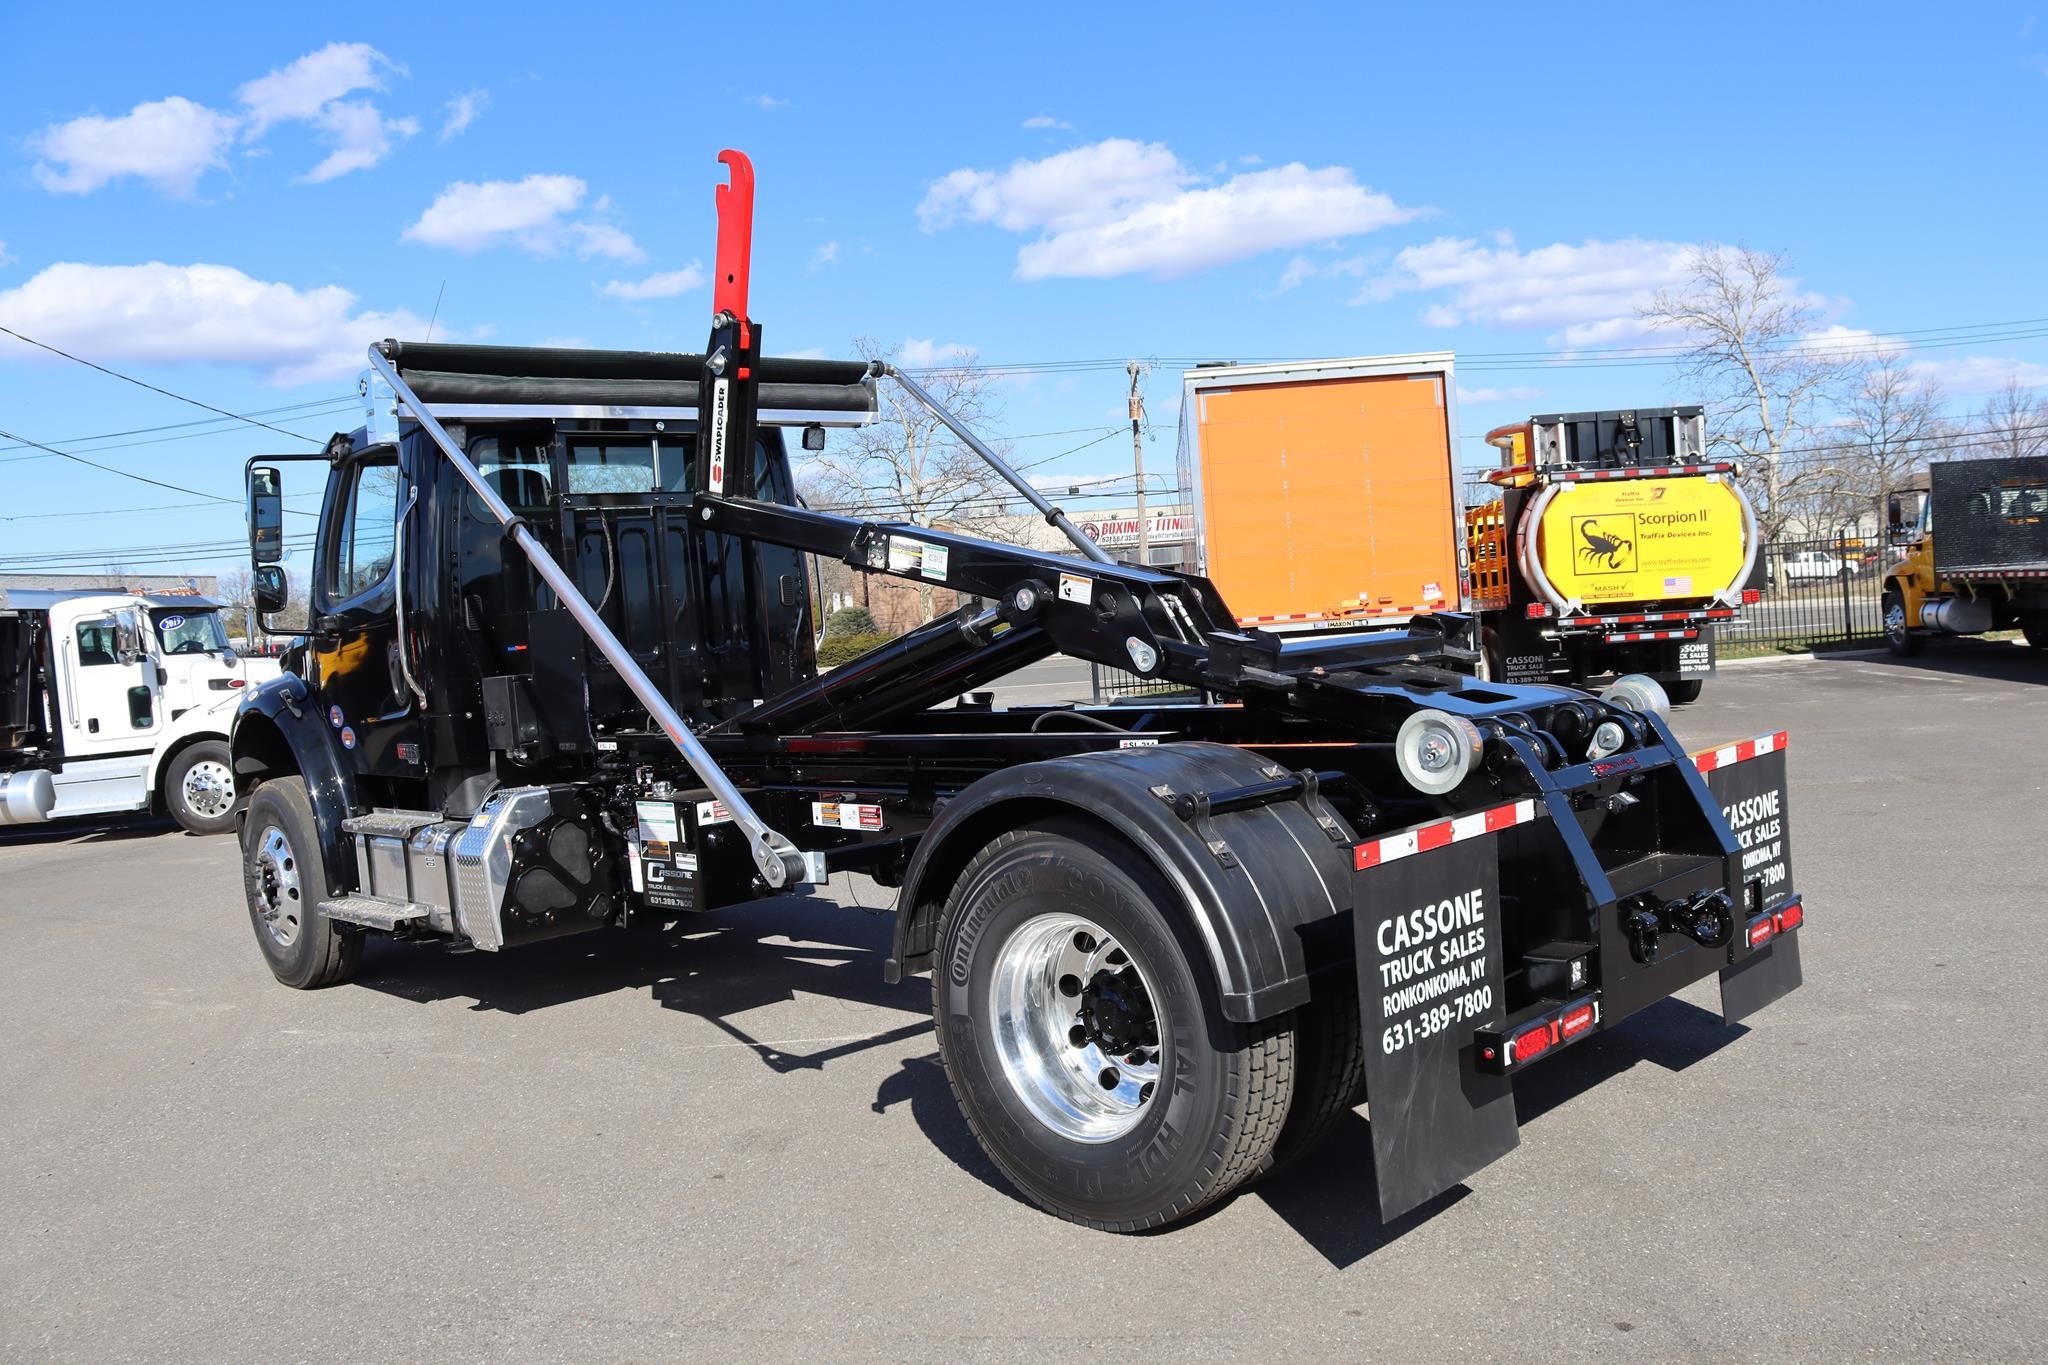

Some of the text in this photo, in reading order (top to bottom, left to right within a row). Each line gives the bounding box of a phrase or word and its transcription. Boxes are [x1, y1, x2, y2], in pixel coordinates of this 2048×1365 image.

[714, 387, 726, 462] SWAPLOADER
[1156, 517, 1182, 531] FITN
[1638, 509, 1708, 527] Scorpion II
[1667, 530, 1696, 538] Devices
[1594, 584, 1619, 592] MASH
[165, 616, 181, 629] 2019
[1689, 651, 1709, 659] SALES
[1506, 675, 1550, 684] 631-389-7800
[1755, 818, 1781, 845] SALES
[1773, 840, 1782, 857] NY
[647, 862, 693, 882] CASSONE
[650, 896, 693, 908] 631.389.7800
[950, 868, 1022, 987] Continental
[1377, 888, 1485, 956] CASSONE
[1379, 927, 1486, 988] TRUCK SALES
[1382, 956, 1487, 1018] RONKONKOMA, NY
[1382, 985, 1492, 1055] 631-389-7800
